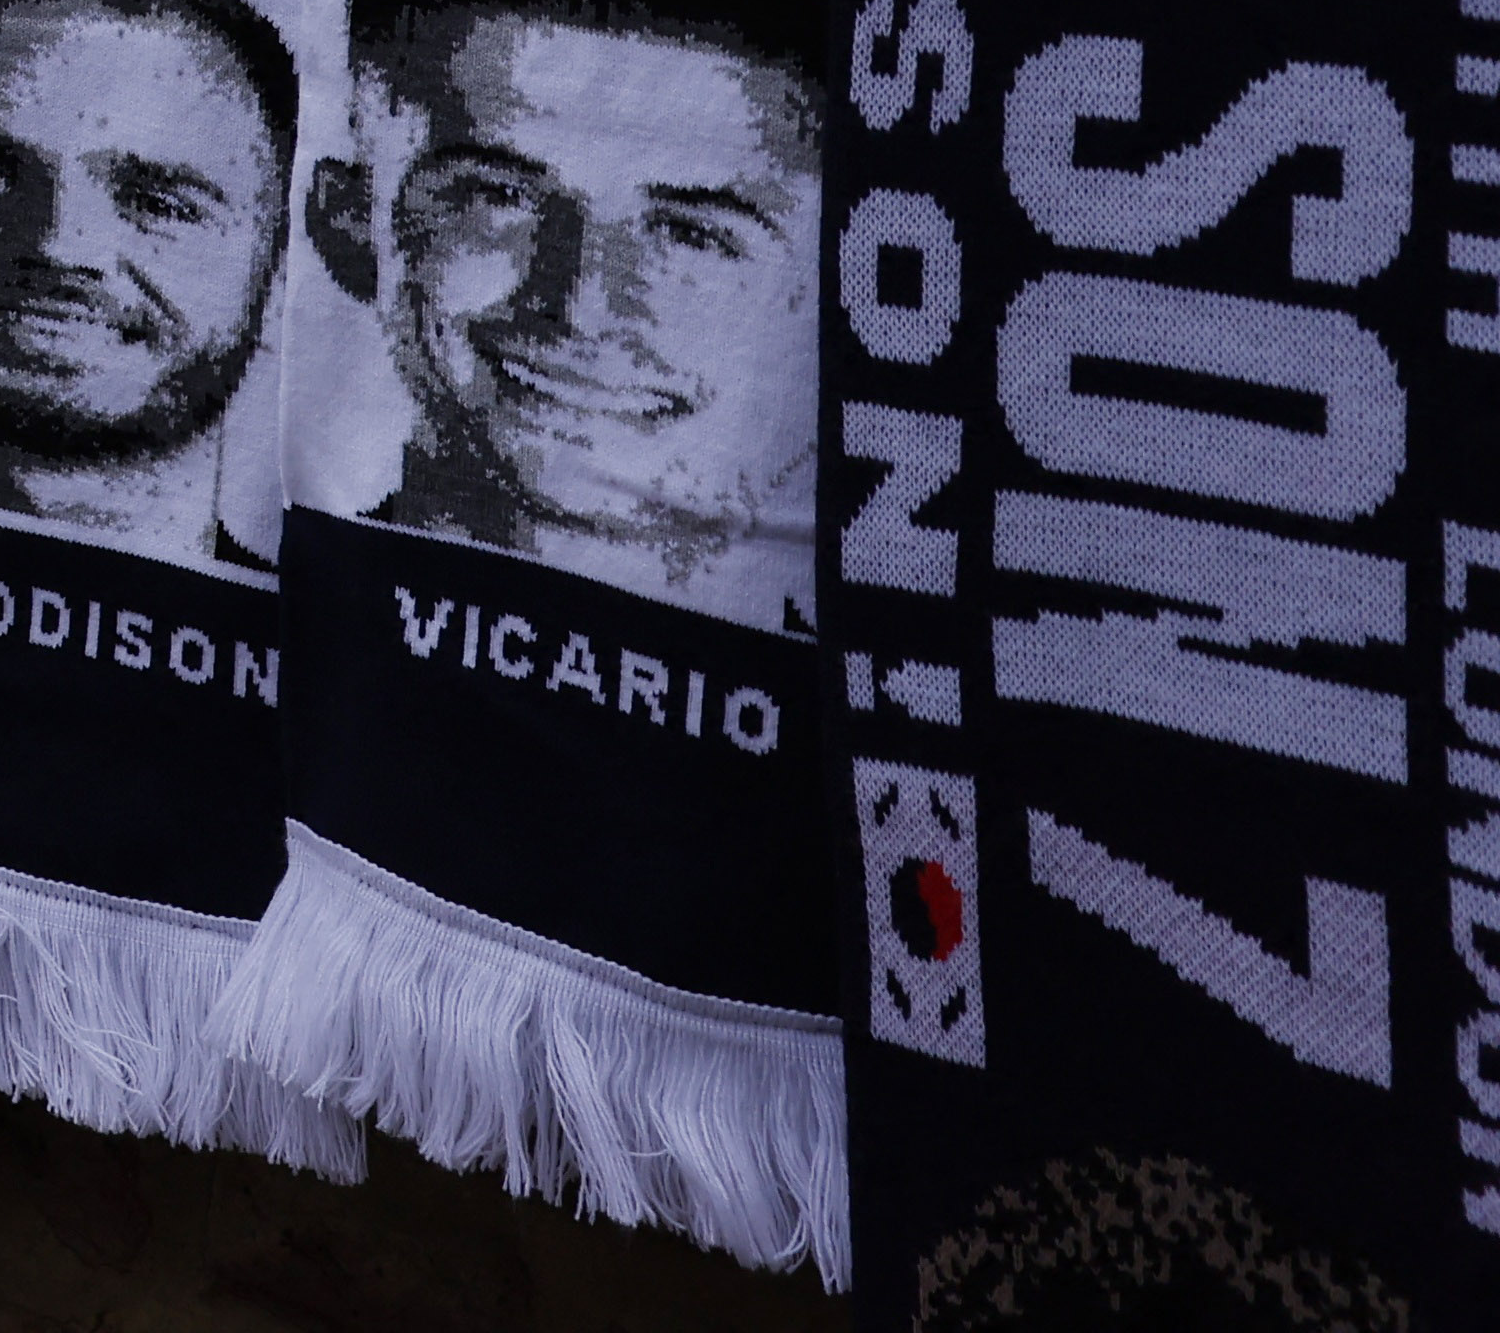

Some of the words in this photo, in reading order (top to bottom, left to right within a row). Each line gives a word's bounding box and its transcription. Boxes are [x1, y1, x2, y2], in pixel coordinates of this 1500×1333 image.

[992, 33, 1415, 786] SON
[392, 585, 781, 756] VICARIO
[1027, 806, 1394, 1091] 7
